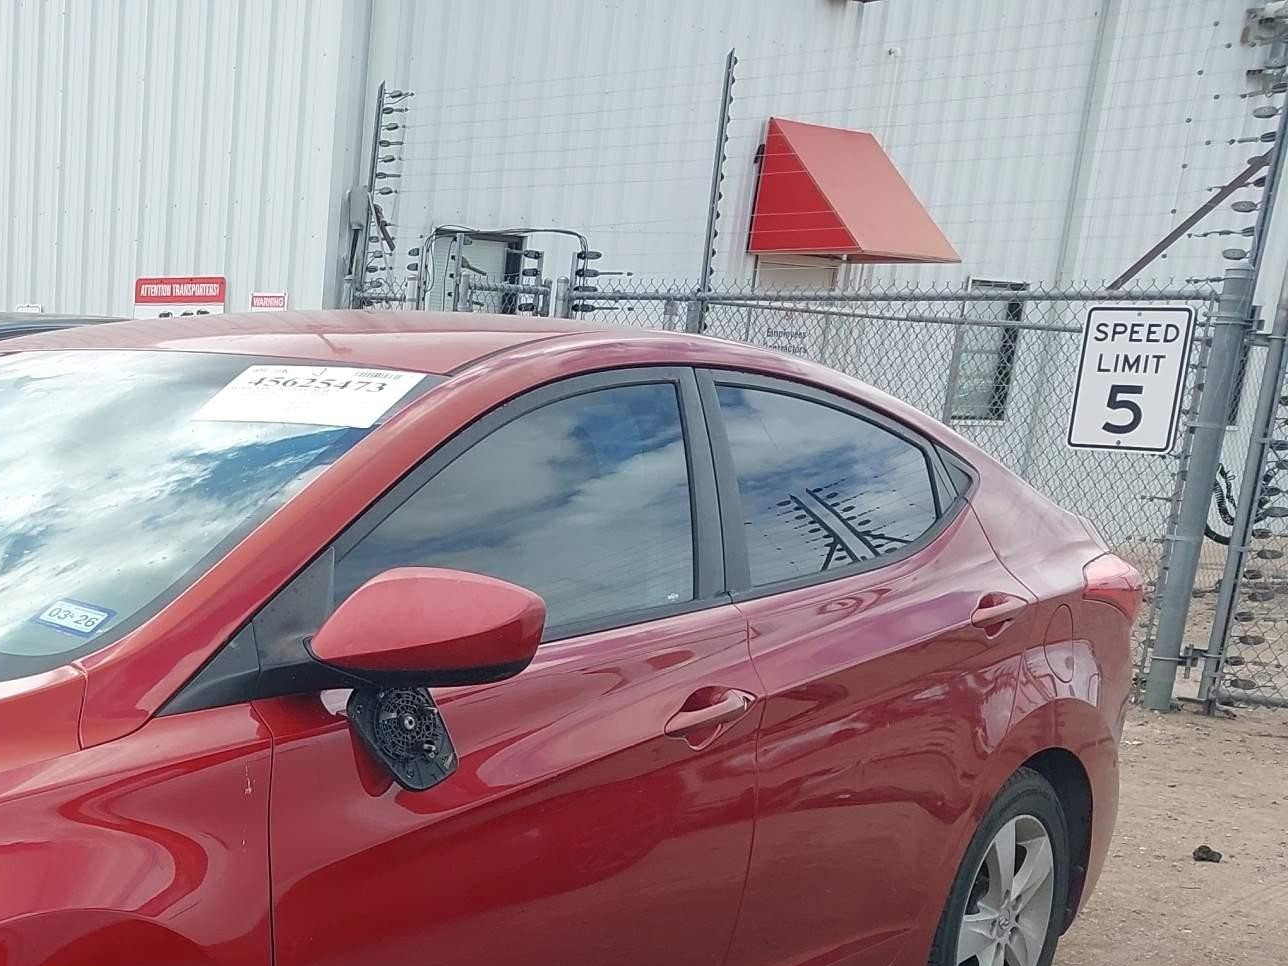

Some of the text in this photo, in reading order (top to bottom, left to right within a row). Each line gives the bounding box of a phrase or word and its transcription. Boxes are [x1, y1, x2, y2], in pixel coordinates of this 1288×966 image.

[140, 284, 171, 297] ATTENTION
[253, 297, 284, 306] WARNING
[1094, 323, 1180, 343] SPEED
[1097, 353, 1167, 374] LIMIT
[248, 377, 388, 392] 45625473
[1102, 384, 1144, 434] 5
